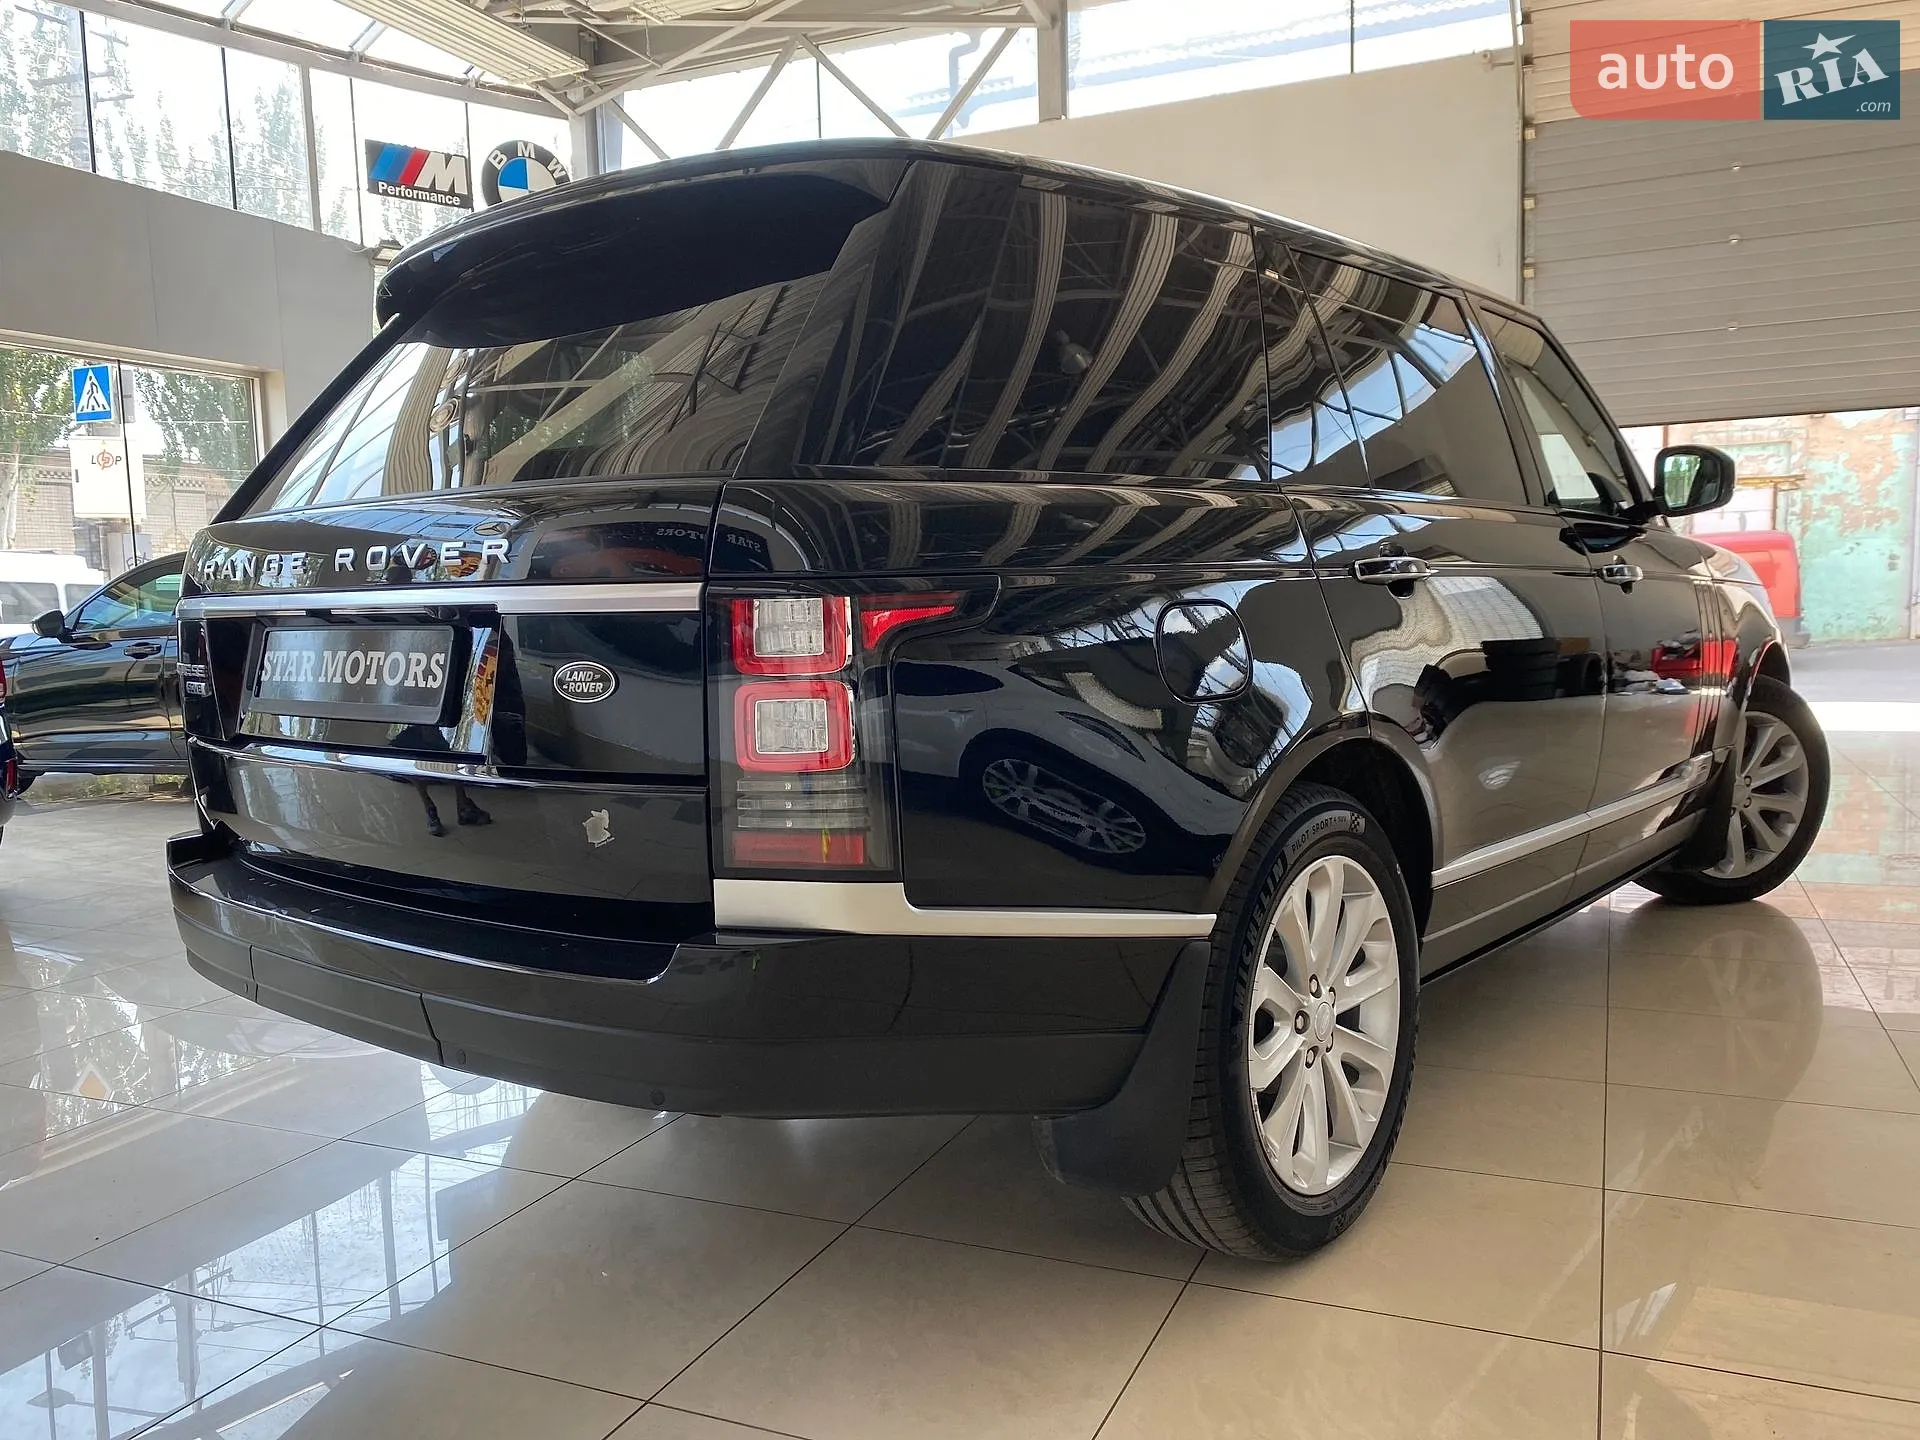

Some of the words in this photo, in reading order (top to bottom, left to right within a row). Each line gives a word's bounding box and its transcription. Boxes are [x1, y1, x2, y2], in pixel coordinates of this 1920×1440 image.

[489, 141, 566, 178] BMW
[378, 181, 460, 206] Performance
[203, 552, 308, 580] RANGE
[334, 538, 511, 572] ROVER
[261, 650, 316, 683] STAR
[318, 650, 446, 689] MOTORS
[1291, 830, 1310, 854] PILOT
[1312, 818, 1332, 835] SPORT
